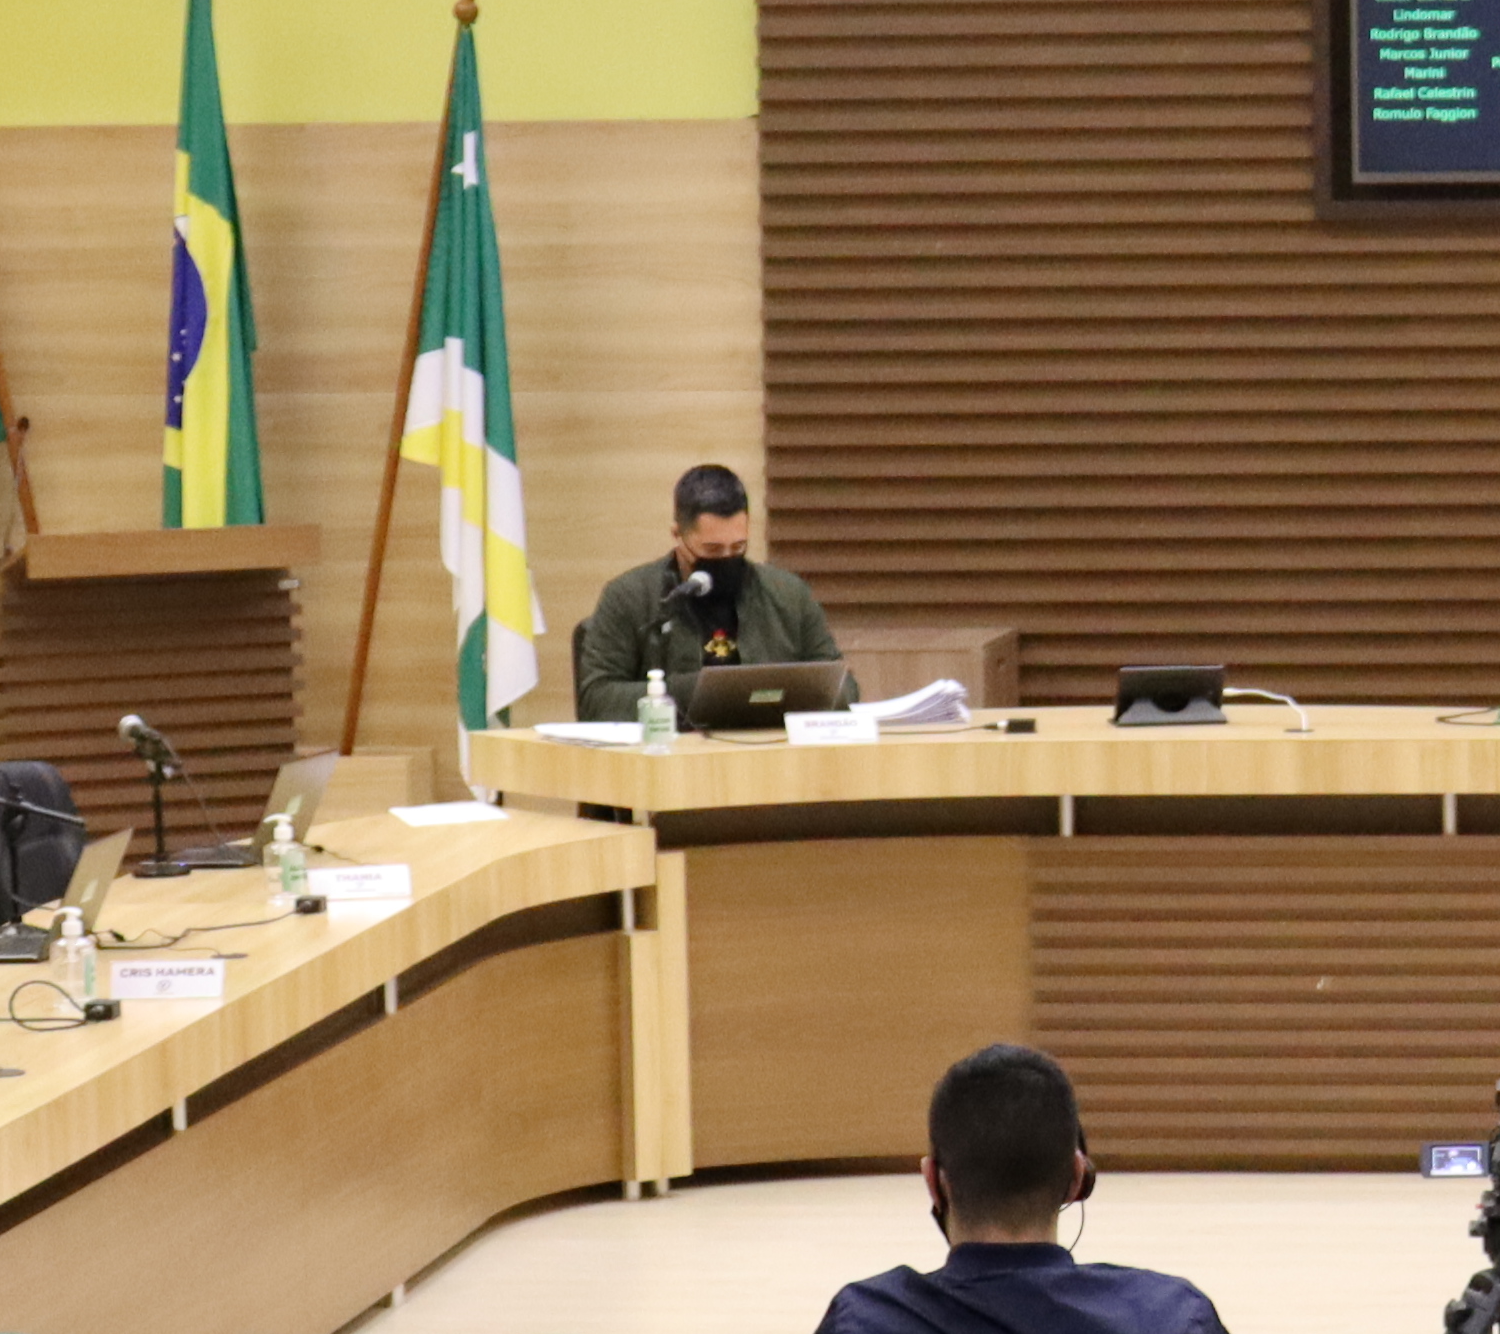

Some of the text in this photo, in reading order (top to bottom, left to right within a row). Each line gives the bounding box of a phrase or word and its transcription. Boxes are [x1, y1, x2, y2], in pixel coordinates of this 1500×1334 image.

[1393, 8, 1457, 21] Lindomar
[1370, 26, 1481, 42] Rodrigo Brandão
[1379, 47, 1470, 60] Marcos Junior
[1404, 66, 1446, 80] Marini
[1374, 86, 1478, 100] Rafael Celestrin
[1373, 107, 1479, 122] Romulo Faggion
[120, 967, 152, 977] CRIS
